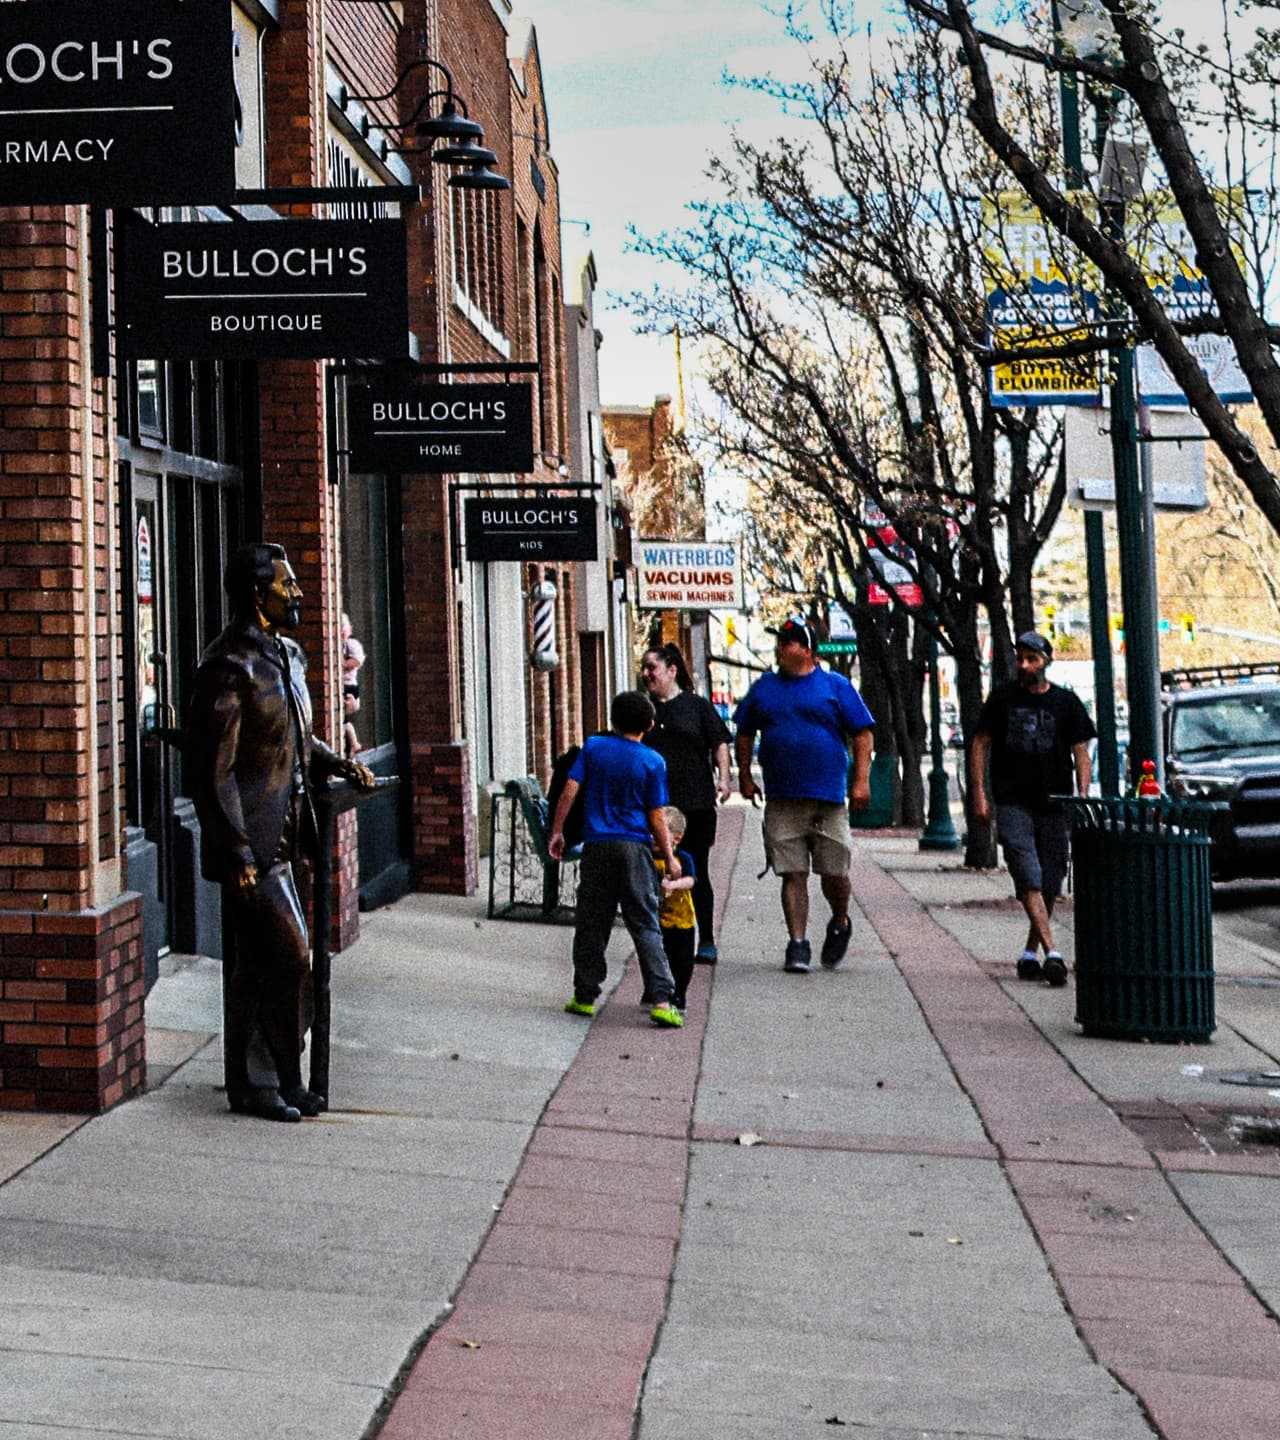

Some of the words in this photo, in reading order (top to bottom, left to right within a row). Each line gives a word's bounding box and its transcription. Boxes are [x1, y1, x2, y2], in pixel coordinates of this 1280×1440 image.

[163, 247, 367, 278] BULLOCH'S
[211, 314, 323, 332] BOUTIQUE
[372, 401, 507, 421] BULLOCH'S
[419, 444, 463, 456] HOME
[481, 510, 579, 525] BULLOCH'S
[519, 541, 543, 550] KIDS
[643, 547, 736, 567] WATERBEDS
[643, 570, 735, 586] VACUUMS
[646, 590, 683, 602] SEWING
[686, 591, 735, 603] MACHINES
